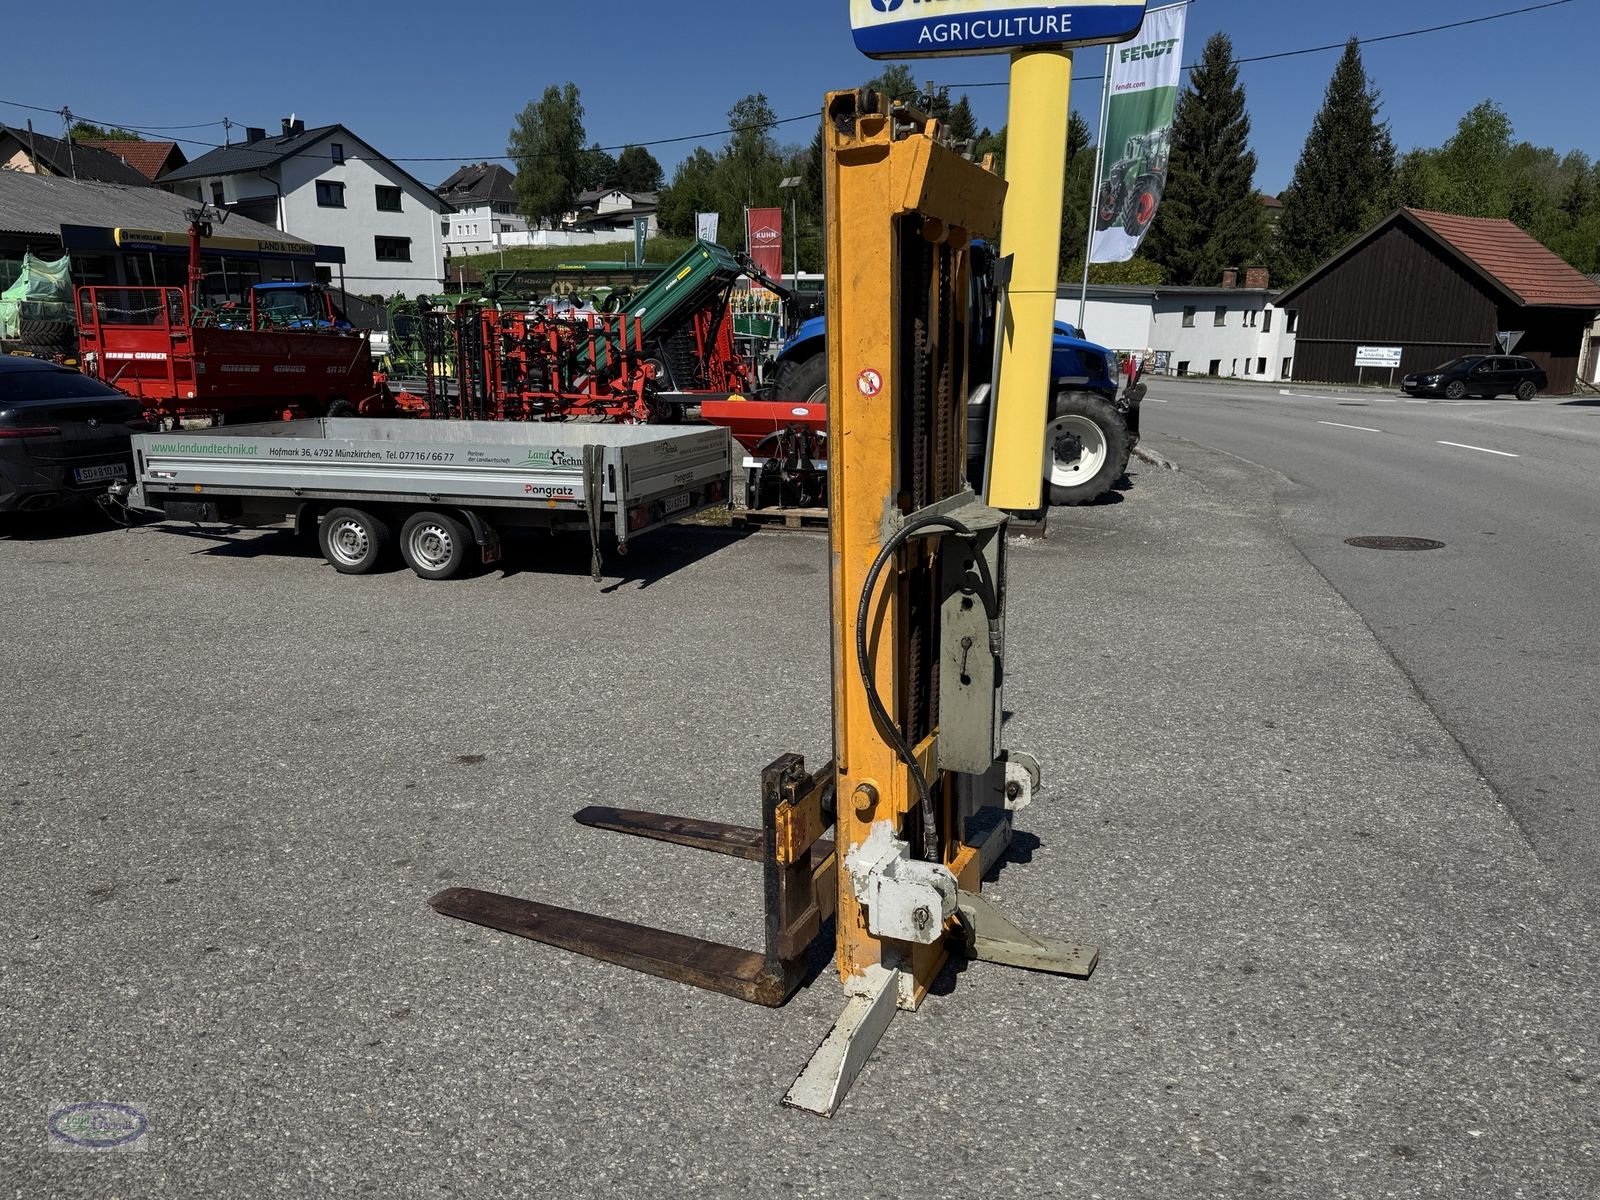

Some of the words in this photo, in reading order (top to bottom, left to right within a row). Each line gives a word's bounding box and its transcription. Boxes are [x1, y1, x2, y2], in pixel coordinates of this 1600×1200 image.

[918, 14, 1072, 43] AGRICULTURE
[1120, 38, 1179, 63] FENDT
[1115, 82, 1145, 91] fendt.com
[260, 240, 279, 251] LAND
[287, 243, 315, 253] TECHNIK
[151, 442, 258, 455] www.landundtechnik.at
[269, 447, 299, 457] Hofmark
[301, 448, 312, 457] 36,
[313, 448, 334, 457] 4792
[335, 449, 382, 460] Münzkirchen,
[386, 450, 398, 460] Tel.
[528, 450, 549, 460] Land
[557, 456, 584, 466] Techn
[524, 484, 574, 497] Pongratz
